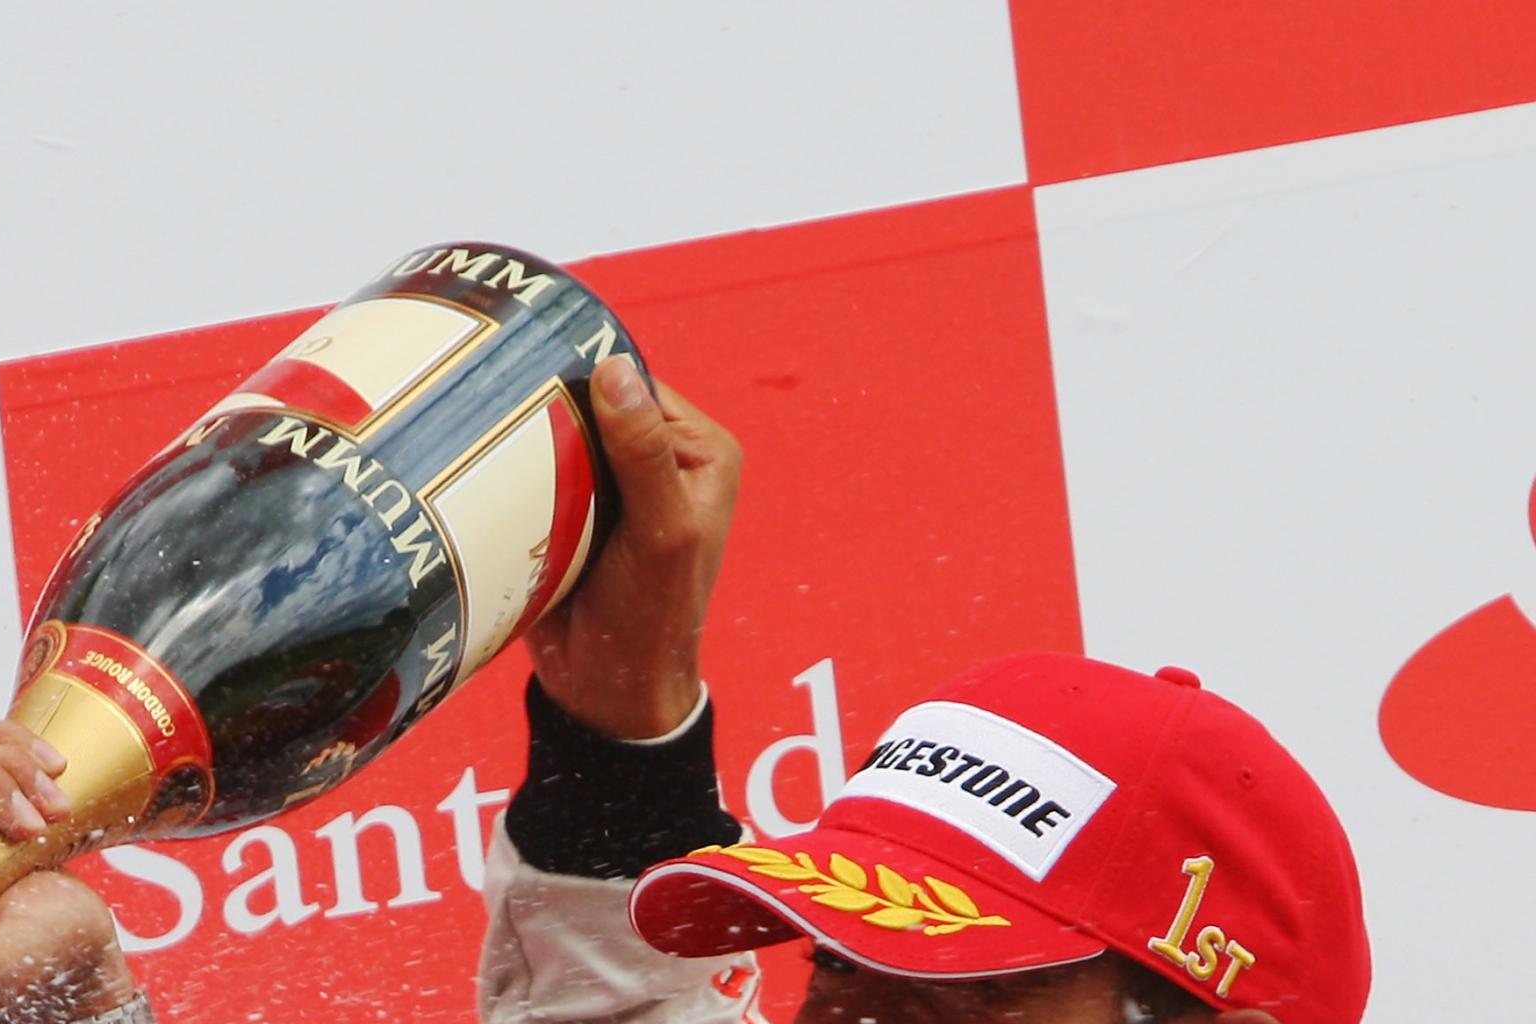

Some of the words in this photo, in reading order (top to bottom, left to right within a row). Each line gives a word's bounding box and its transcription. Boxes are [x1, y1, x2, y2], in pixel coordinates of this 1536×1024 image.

[372, 248, 557, 307] UMM
[257, 415, 447, 589] MUMM
[79, 649, 135, 684] ROUGE
[126, 674, 177, 738] CORDON
[1148, 855, 1256, 999] 1ST
